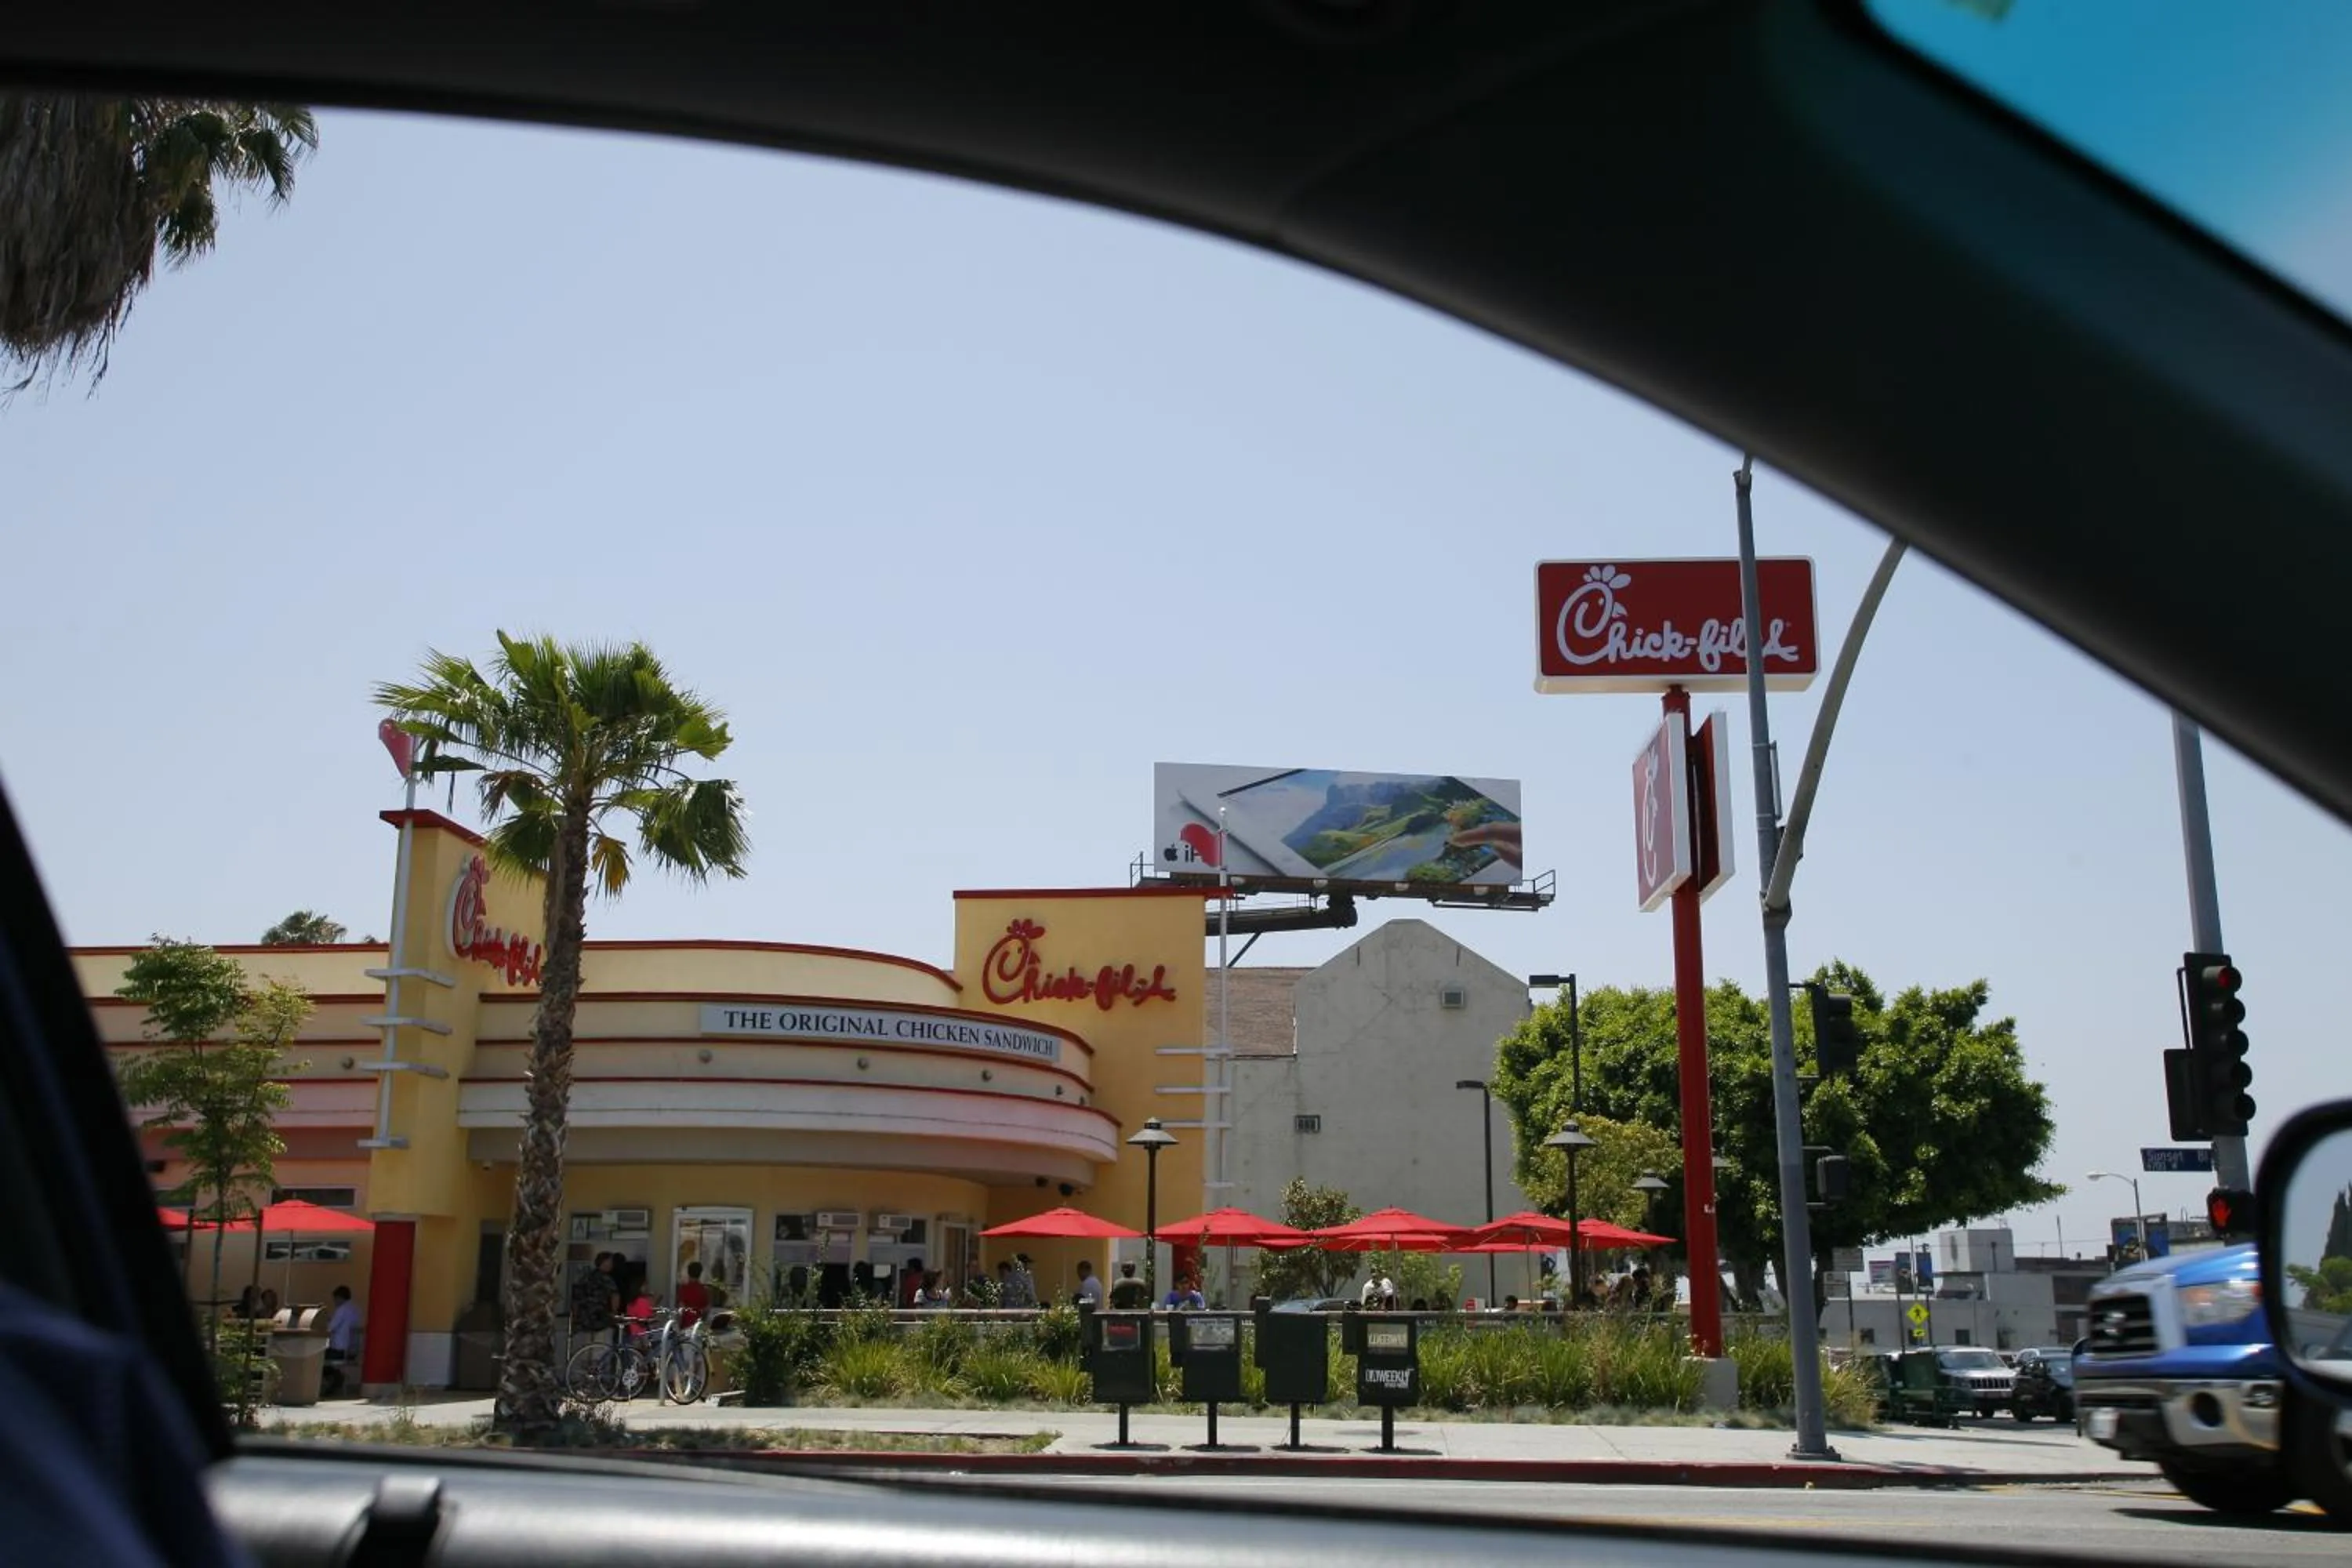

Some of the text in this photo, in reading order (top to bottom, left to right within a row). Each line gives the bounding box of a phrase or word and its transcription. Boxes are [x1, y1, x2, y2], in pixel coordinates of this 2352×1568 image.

[1556, 564, 1799, 672] Chick-filA
[982, 918, 1176, 1011] Chick-fil-A
[724, 1010, 1054, 1055] THE ORIGINAL CHICKEN SANDWICH
